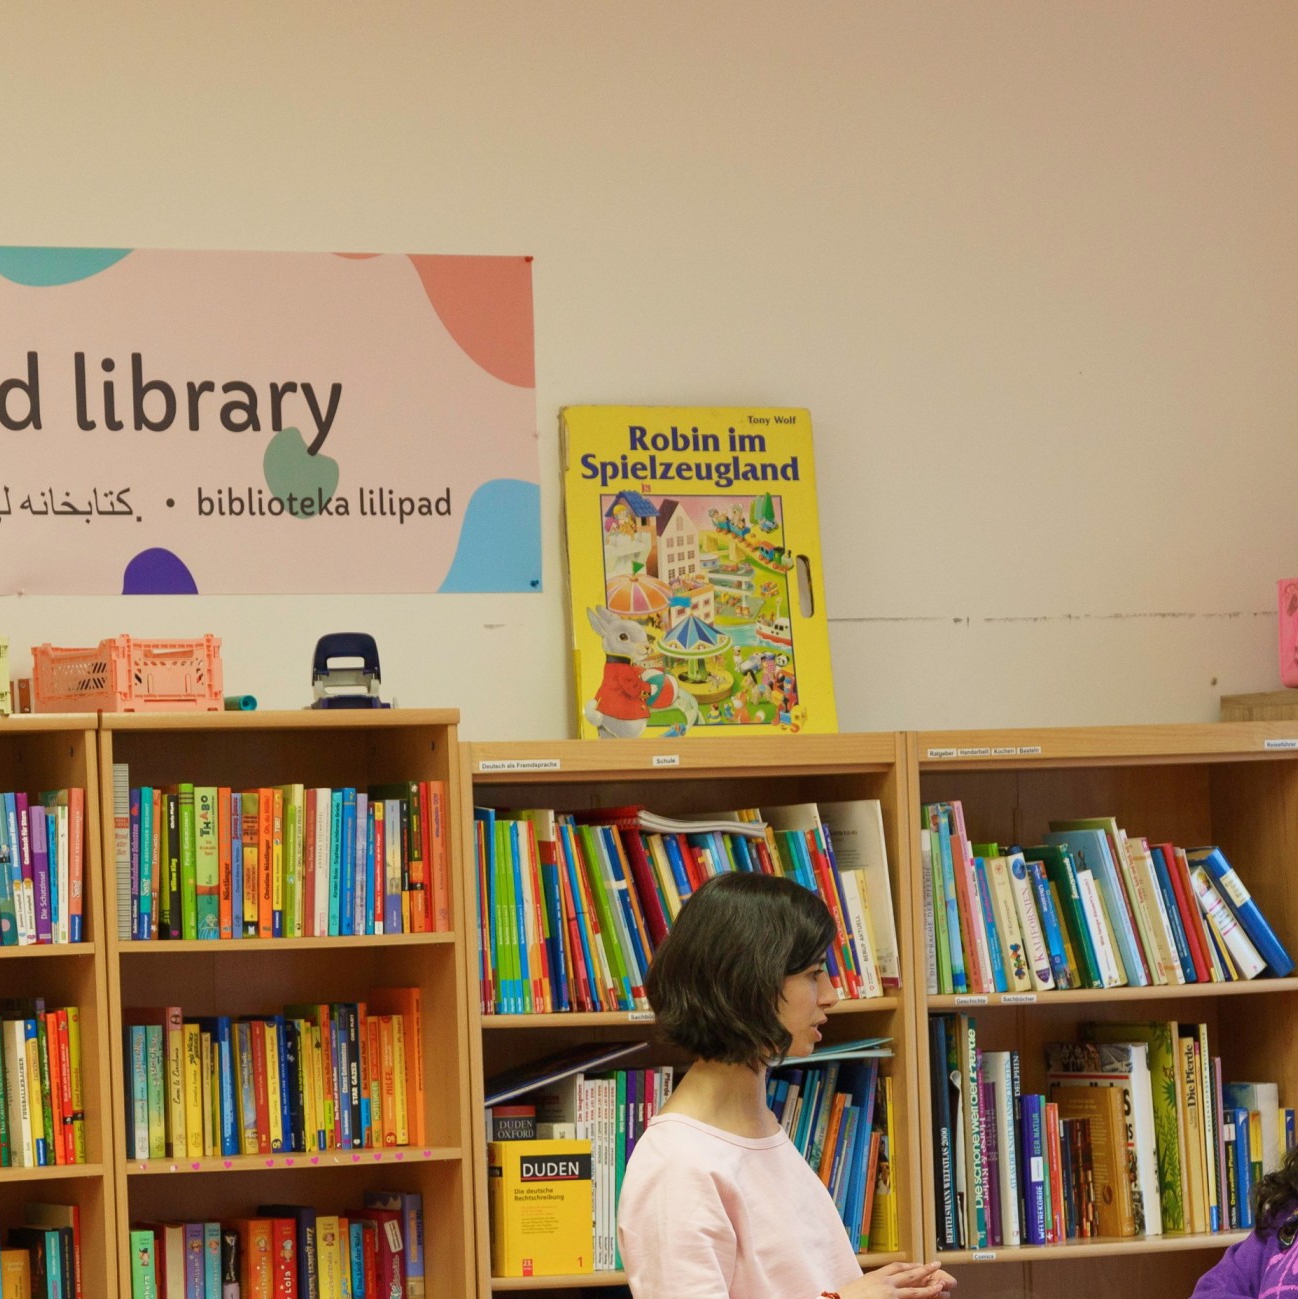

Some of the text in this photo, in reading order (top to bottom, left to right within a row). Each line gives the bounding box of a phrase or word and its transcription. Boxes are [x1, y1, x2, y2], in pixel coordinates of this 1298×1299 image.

[74, 351, 343, 457] library
[747, 415, 796, 426] Tony Wolf
[629, 426, 766, 452] Robin im
[581, 453, 799, 488] Spielzeugland
[196, 487, 452, 526] biblioteka lilipad
[516, 761, 557, 770] Fremdsprache
[200, 795, 211, 837] THABO
[263, 839, 271, 871] Nöstlinger
[38, 871, 47, 906] Schatzinsel
[223, 863, 231, 900] Nöstlinger
[1021, 887, 1045, 962] KALIFORNIEN
[1013, 1055, 1021, 1096] DELPHIN
[1185, 1044, 1197, 1107] Die Pferde
[351, 1088, 359, 1105] STAR
[497, 1129, 534, 1140] OXFORD
[499, 1119, 532, 1130] DUDEN
[522, 1161, 579, 1178] DUDEN
[942, 1147, 951, 1189] WELTATLAS
[1032, 1113, 1045, 1239] WELTREKORDE DER NATUR
[514, 1193, 564, 1202] Rechtschreibung
[943, 1190, 954, 1243] BERTELSMANN
[577, 1256, 583, 1268] 1
[283, 1270, 293, 1294] Lola
